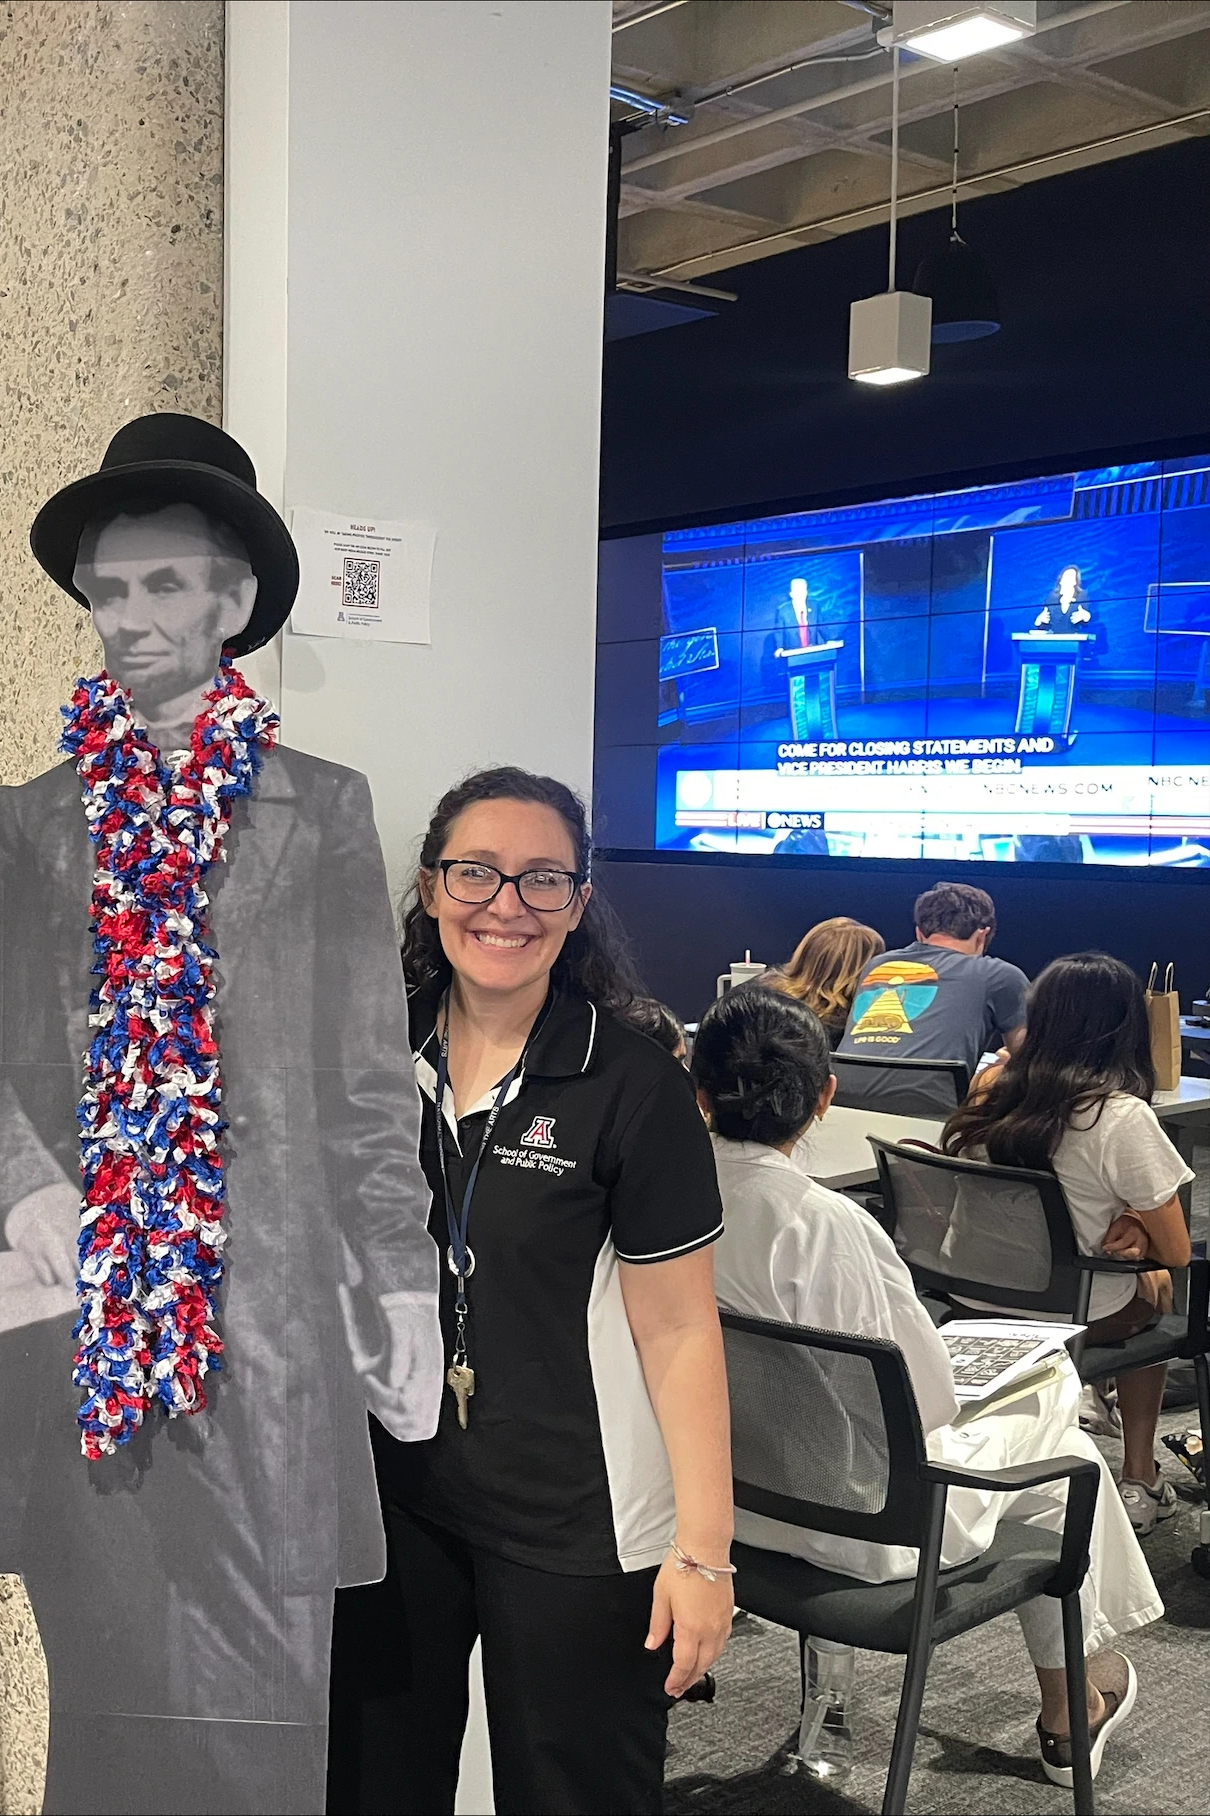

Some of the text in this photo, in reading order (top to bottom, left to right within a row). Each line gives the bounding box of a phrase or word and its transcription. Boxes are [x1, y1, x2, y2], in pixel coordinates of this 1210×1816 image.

[778, 737, 1054, 758] COME FOR CLOSING STATEMENTS AND
[777, 758, 1021, 775] VICE PRESIDENT HARRIS WE BEGIN
[780, 813, 822, 828] NEWS
[488, 1106, 500, 1130] ARTS
[520, 1116, 556, 1148] A
[493, 1145, 518, 1157] School
[518, 1149, 528, 1158] of
[529, 1151, 576, 1168] Government
[500, 1157, 564, 1176] and Public Policy
